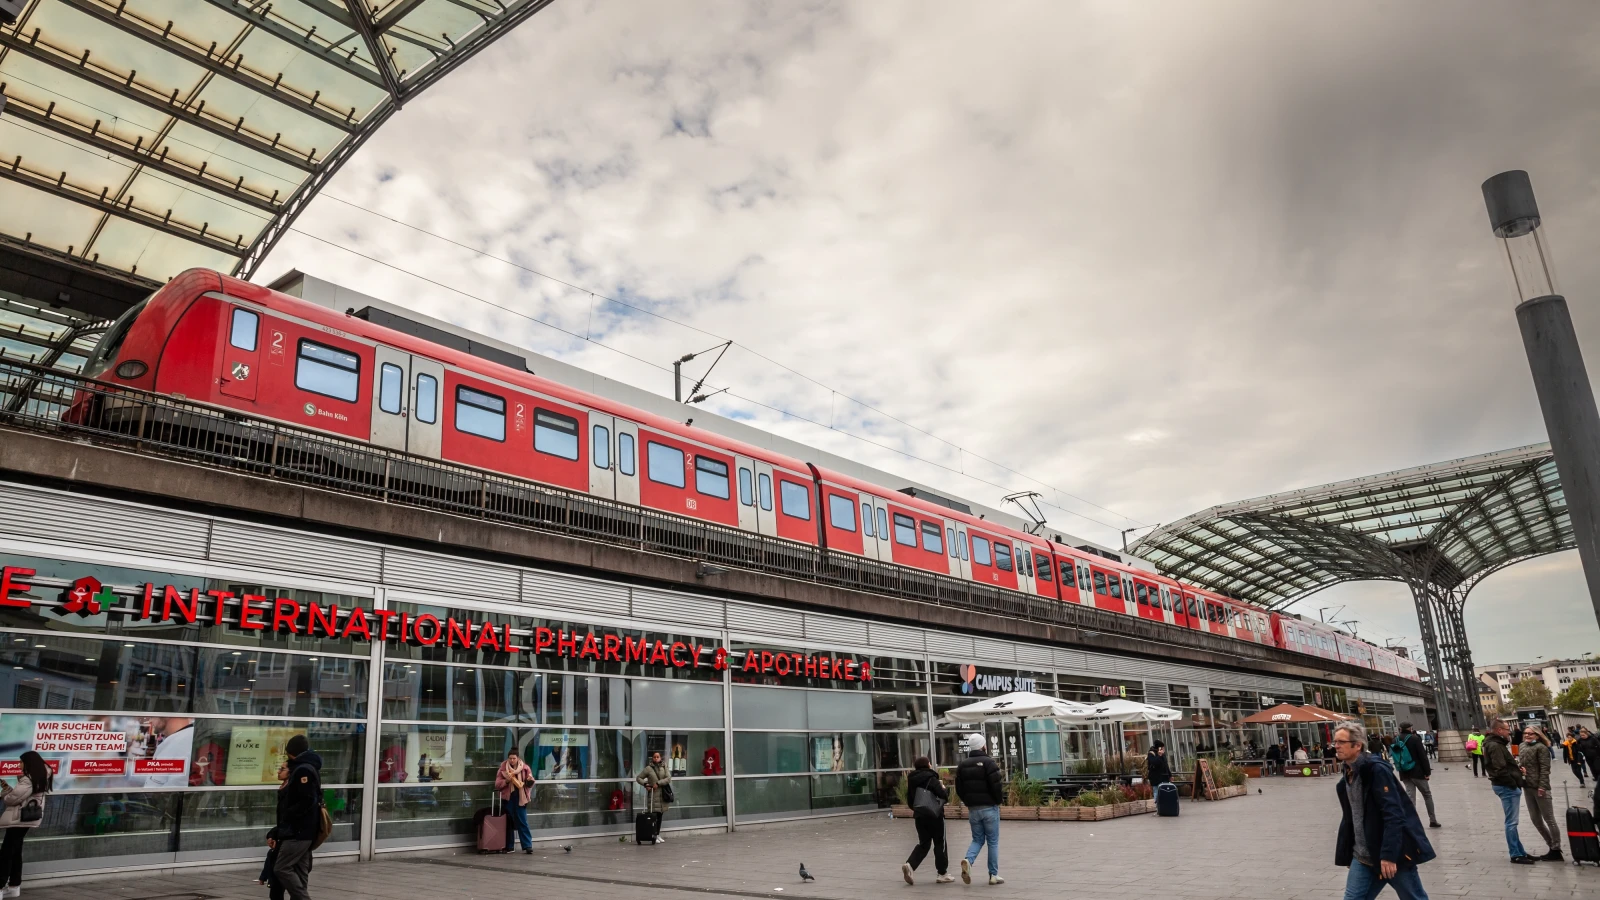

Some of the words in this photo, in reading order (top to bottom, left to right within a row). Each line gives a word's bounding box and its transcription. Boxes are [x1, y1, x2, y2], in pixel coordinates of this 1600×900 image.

[272, 332, 283, 348] 2
[305, 403, 315, 415] S
[318, 408, 333, 418] Bahn
[334, 412, 348, 422] Köln
[516, 404, 524, 418] 2
[686, 454, 692, 466] 2
[686, 498, 696, 510] DB
[916, 520, 920, 529] 2
[142, 582, 520, 653] INTERNATIONAL
[535, 626, 703, 668] PHARMACY
[743, 650, 854, 680] APOTHEKE
[976, 674, 1012, 692] CAMPUS
[1014, 678, 1036, 692] SUITE
[61, 722, 102, 730] SUCHEN
[36, 732, 124, 741] UNTERSTÜTZUNG
[35, 742, 56, 750] FÜR
